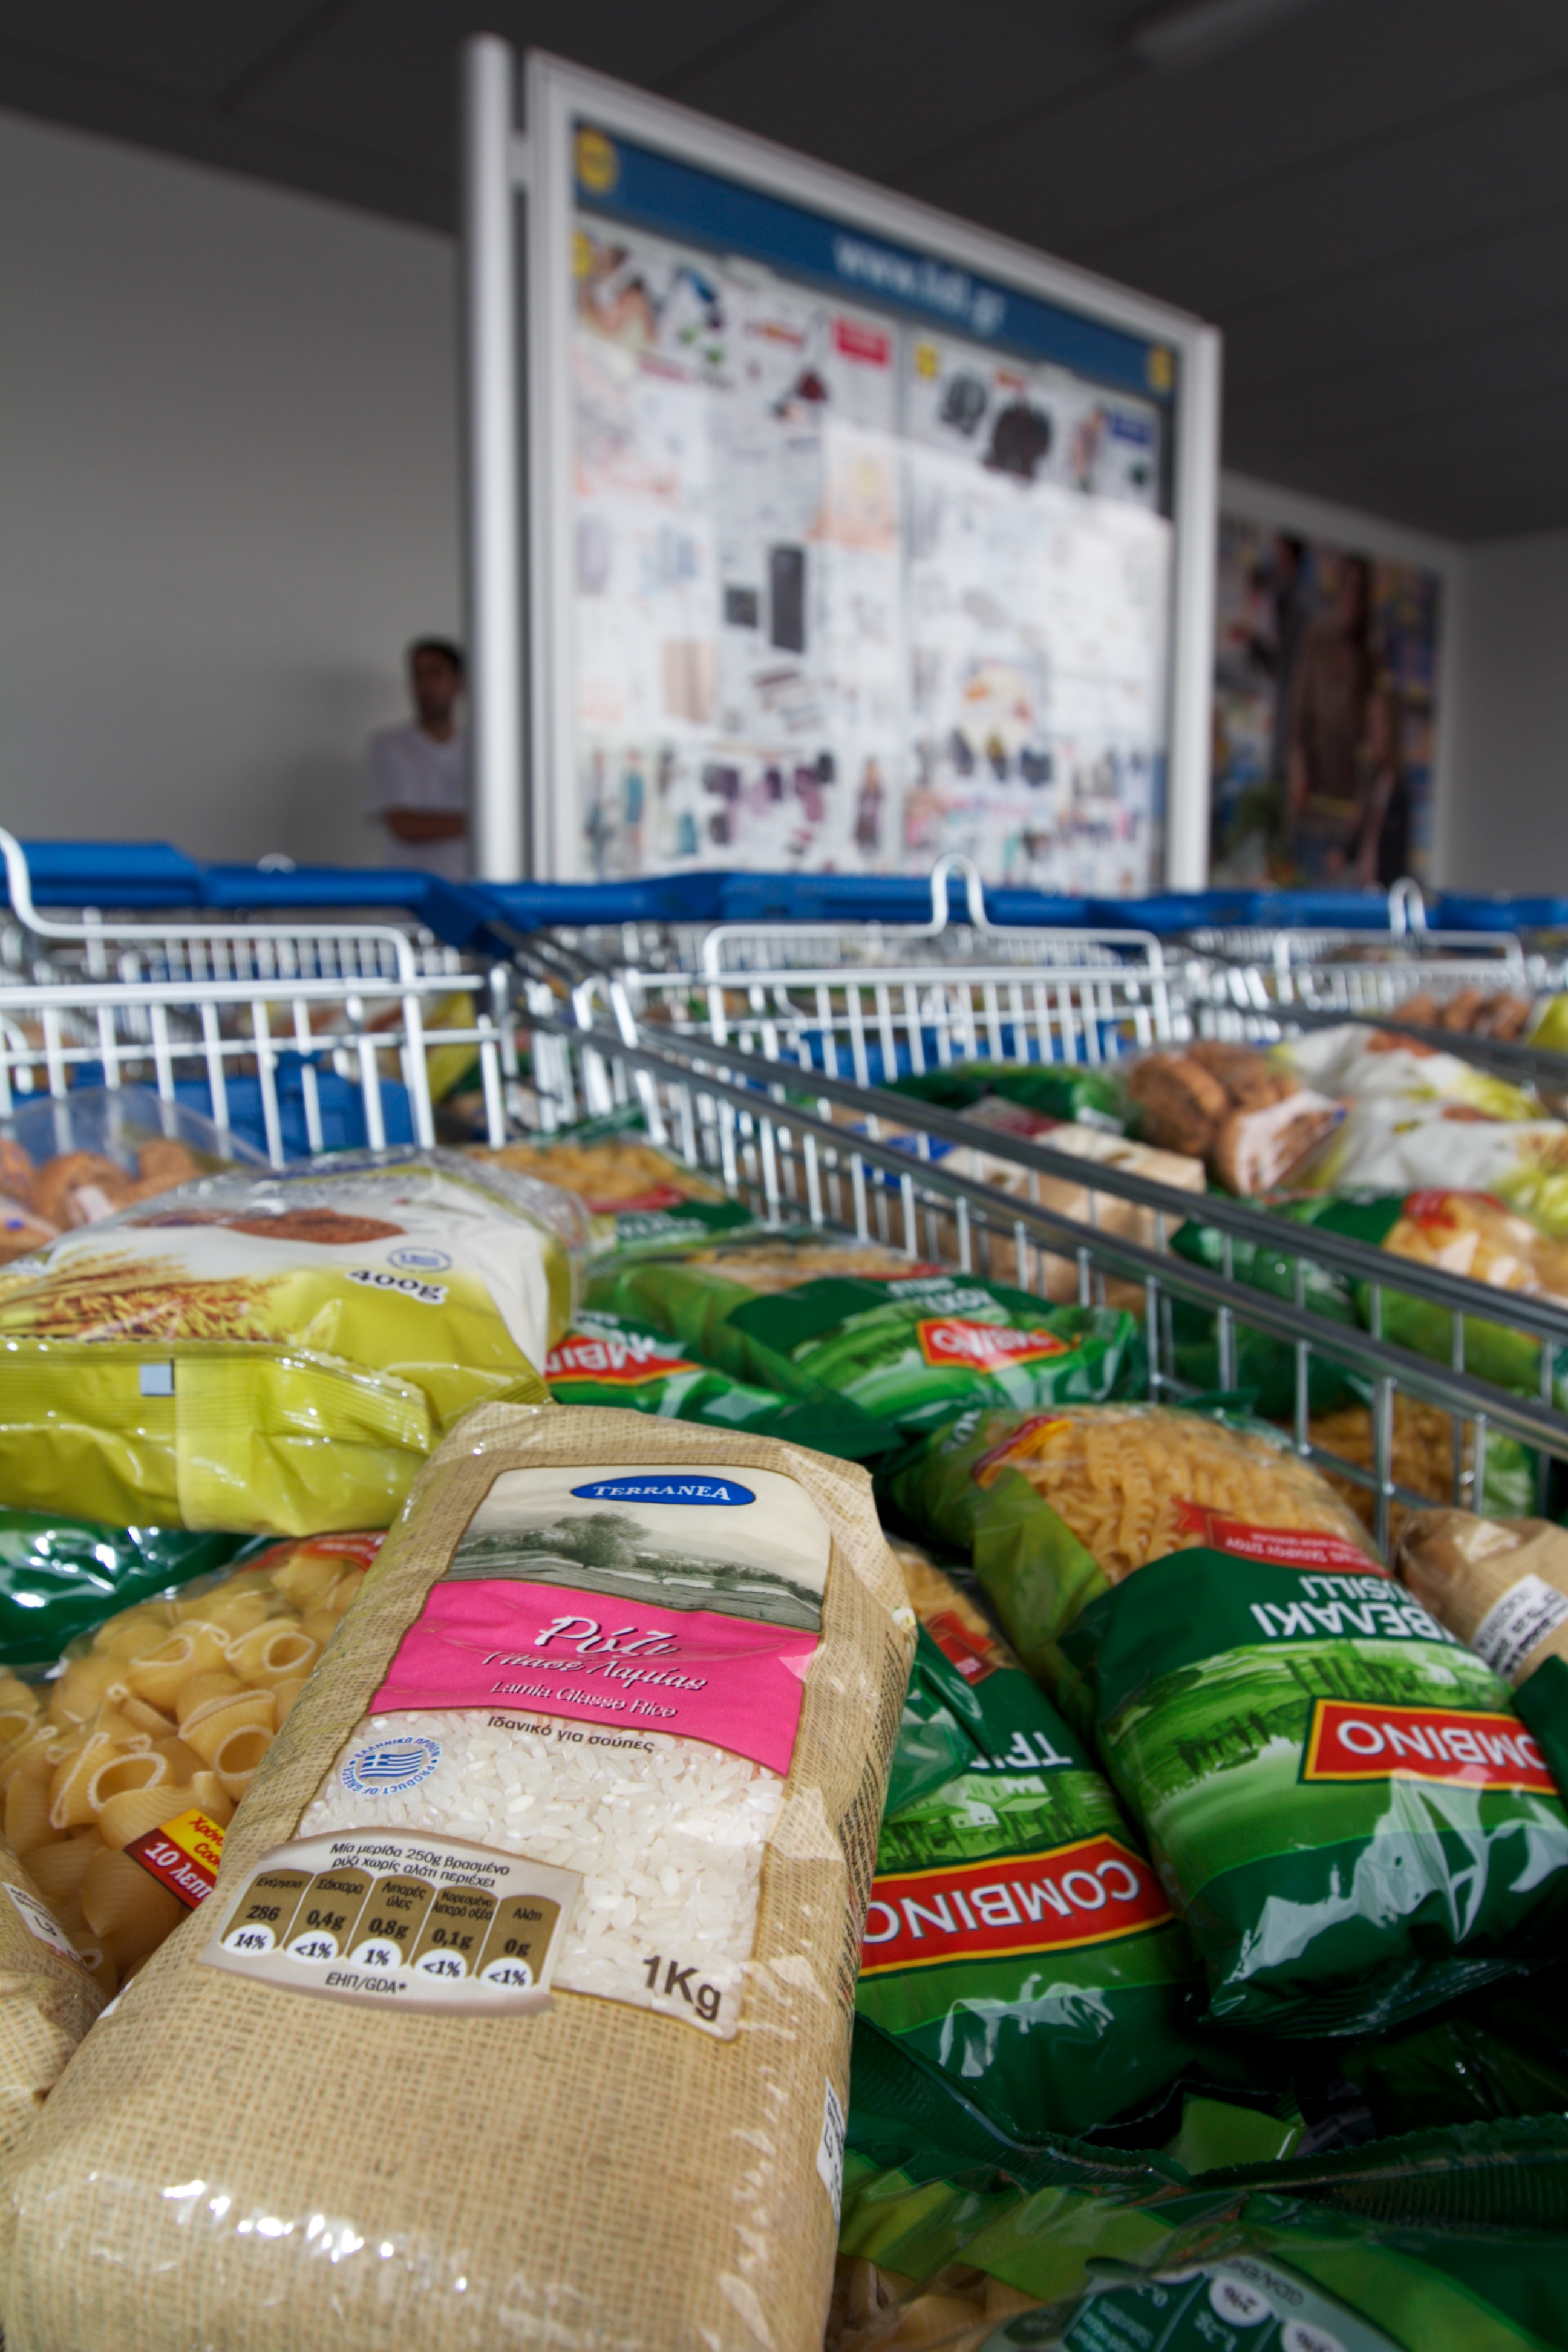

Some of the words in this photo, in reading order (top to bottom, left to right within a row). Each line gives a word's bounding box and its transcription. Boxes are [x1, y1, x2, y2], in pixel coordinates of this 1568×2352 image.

[350, 1270, 440, 1301] 400g
[593, 1485, 731, 1501] TERRANEA
[1298, 1575, 1425, 1607] USILLI
[534, 1615, 681, 1658] Ρύζι
[490, 1682, 553, 1699] Lamia
[555, 1687, 627, 1711] Glasse
[629, 1699, 678, 1718] Rice
[486, 1716, 552, 1737] Ιδανικό
[557, 1728, 583, 1745] για
[587, 1734, 656, 1754] σούπες
[354, 1737, 413, 1759] ΕΛΛΗΝΙΚΟ
[342, 1766, 364, 1792] GREECE
[362, 1786, 379, 1795] OF
[382, 1765, 436, 1795] PRODUCT
[143, 1841, 180, 1869] 10
[330, 1843, 355, 1855] Μία
[356, 1844, 403, 1858] μερίδα
[405, 1847, 443, 1867] 250g
[443, 1855, 511, 1876] βρασμένο
[332, 1855, 360, 1869] ρύζι
[361, 1857, 402, 1873] χωρίς
[403, 1863, 438, 1879] αλάτι
[439, 1870, 496, 1889] περιέχει
[381, 1880, 427, 1901] Λιπαρές
[863, 1859, 1140, 1944] COMBINO
[245, 1904, 281, 1922] 286
[385, 1895, 413, 1912] ύλες
[512, 1907, 543, 1922] Αλάτι
[305, 1909, 347, 1932] 0,4g
[368, 1916, 410, 1941] 0,8g
[234, 1933, 268, 1951] 14%
[294, 1941, 333, 1960] <1%
[431, 1927, 475, 1951] 0,1g
[363, 1948, 391, 1967] 1%
[422, 1959, 462, 1979] <1%
[487, 1968, 526, 1987] <1%
[642, 1954, 722, 2023] 1Kg
